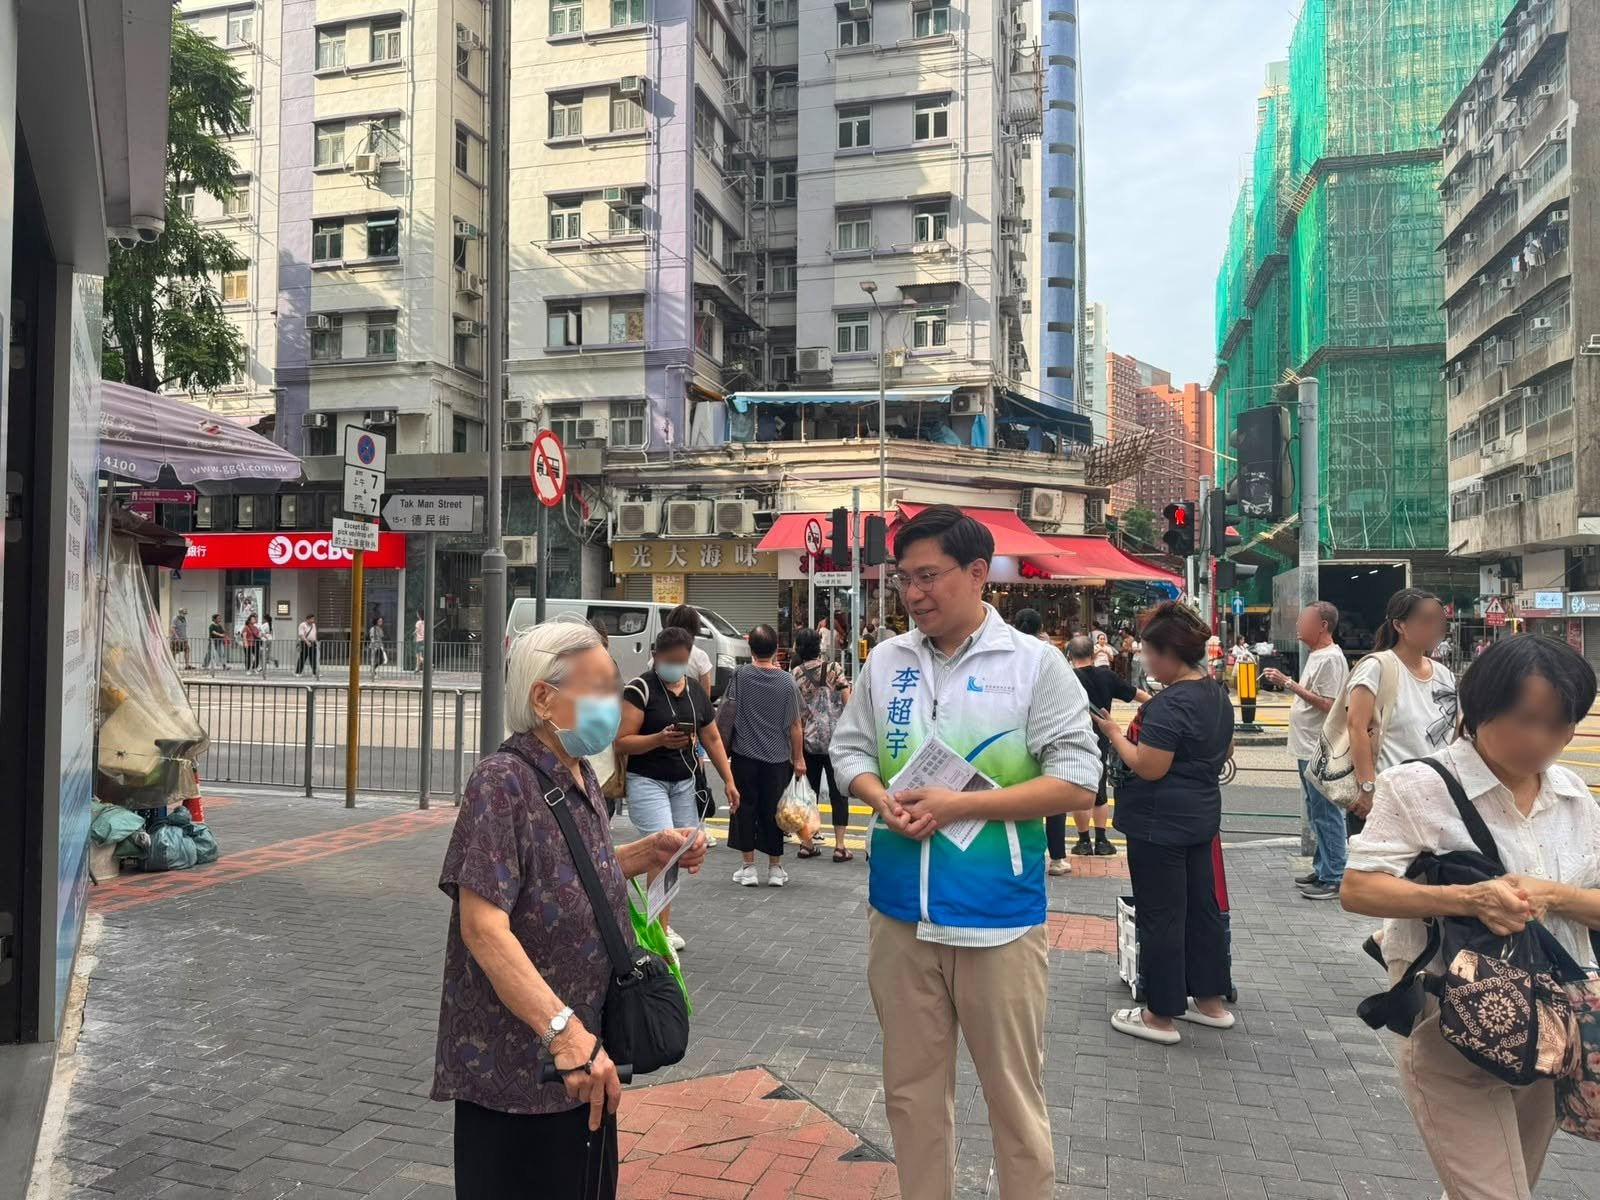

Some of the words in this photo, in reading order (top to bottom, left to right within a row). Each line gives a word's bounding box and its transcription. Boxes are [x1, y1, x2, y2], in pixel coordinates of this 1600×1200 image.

[190, 462, 288, 475] www.ggcl.com.hk
[352, 477, 366, 487] 上午
[371, 474, 378, 489] 7
[352, 501, 365, 512] 下午
[371, 498, 377, 513] 7
[399, 499, 414, 508] Tak
[417, 499, 434, 508] Man
[438, 499, 462, 509] Street
[411, 514, 450, 527] 德民街
[631, 544, 758, 568] 光大海味
[886, 666, 921, 760] 李超宇
